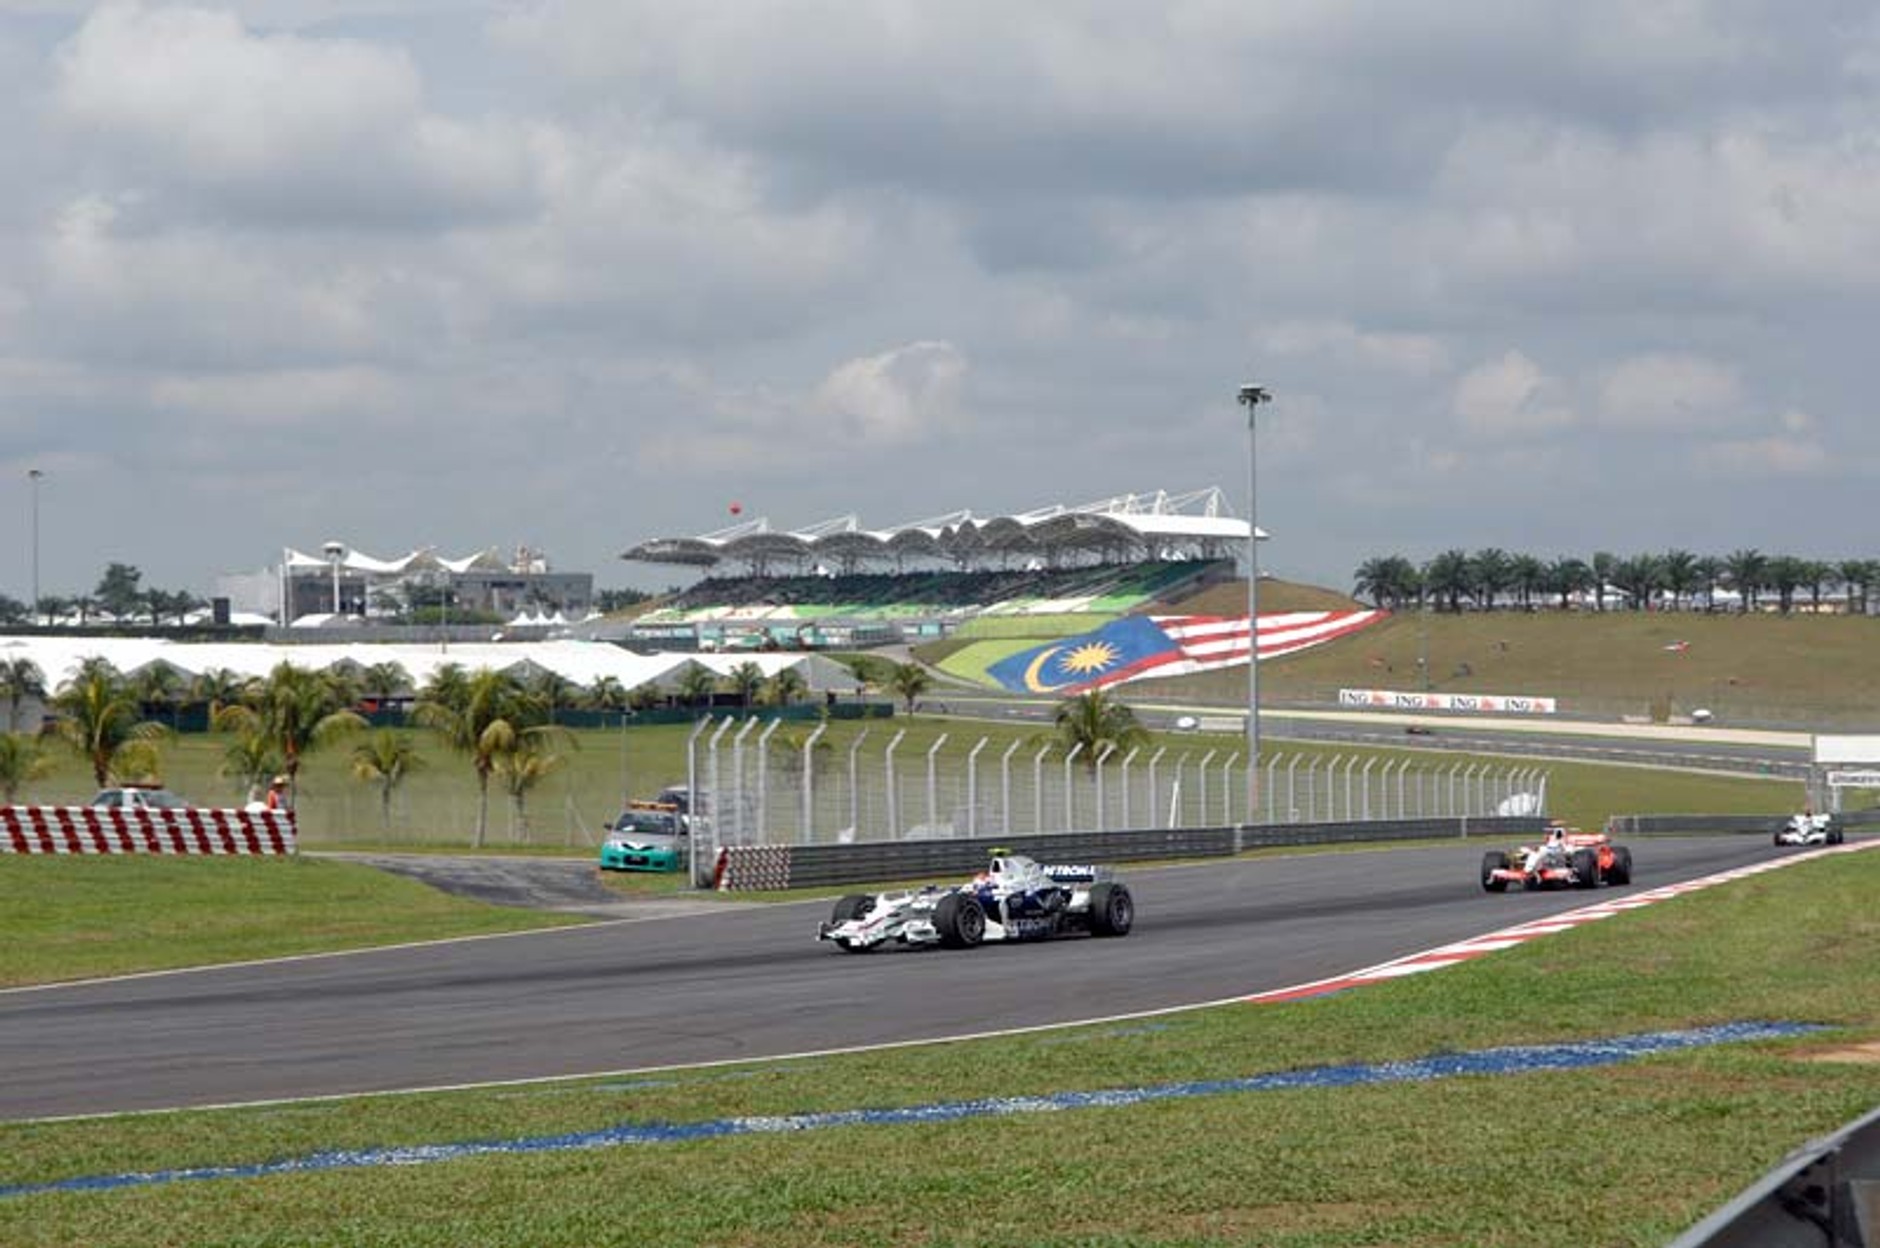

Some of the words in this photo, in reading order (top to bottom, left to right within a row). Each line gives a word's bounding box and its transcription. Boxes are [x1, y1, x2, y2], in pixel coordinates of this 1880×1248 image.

[1341, 691, 1368, 704] ING
[1395, 694, 1423, 707] ING
[1450, 696, 1477, 709] ING
[1504, 698, 1531, 711] ING
